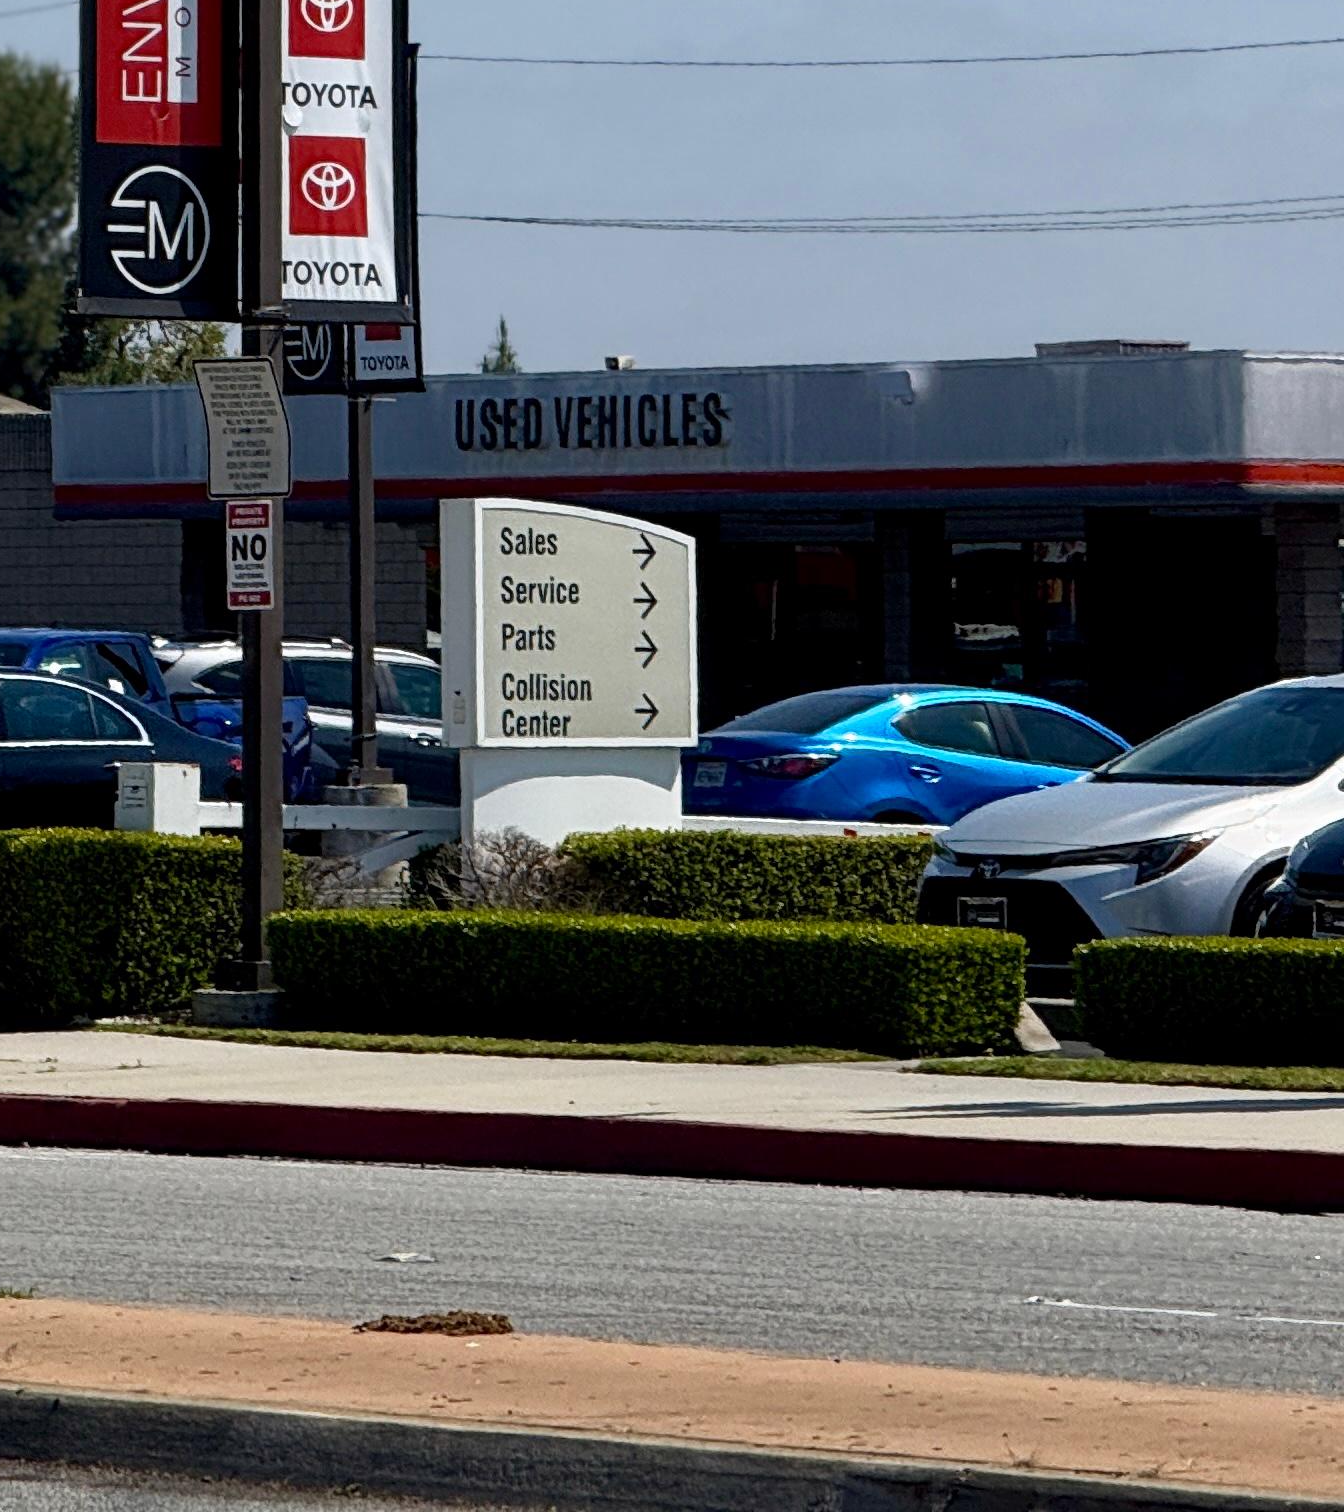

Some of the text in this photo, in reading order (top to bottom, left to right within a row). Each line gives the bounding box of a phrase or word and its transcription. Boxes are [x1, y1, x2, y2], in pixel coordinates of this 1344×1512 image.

[281, 82, 378, 109] TOYOTA
[281, 260, 382, 287] TOYOTA
[360, 354, 410, 371] TOYOTA
[455, 392, 725, 451] USED VEHICLES
[230, 534, 267, 561] NO
[500, 527, 558, 556] Sales
[501, 575, 580, 605] Service
[502, 623, 556, 652] Parts
[502, 672, 592, 702] Collision
[502, 709, 572, 738] Center
